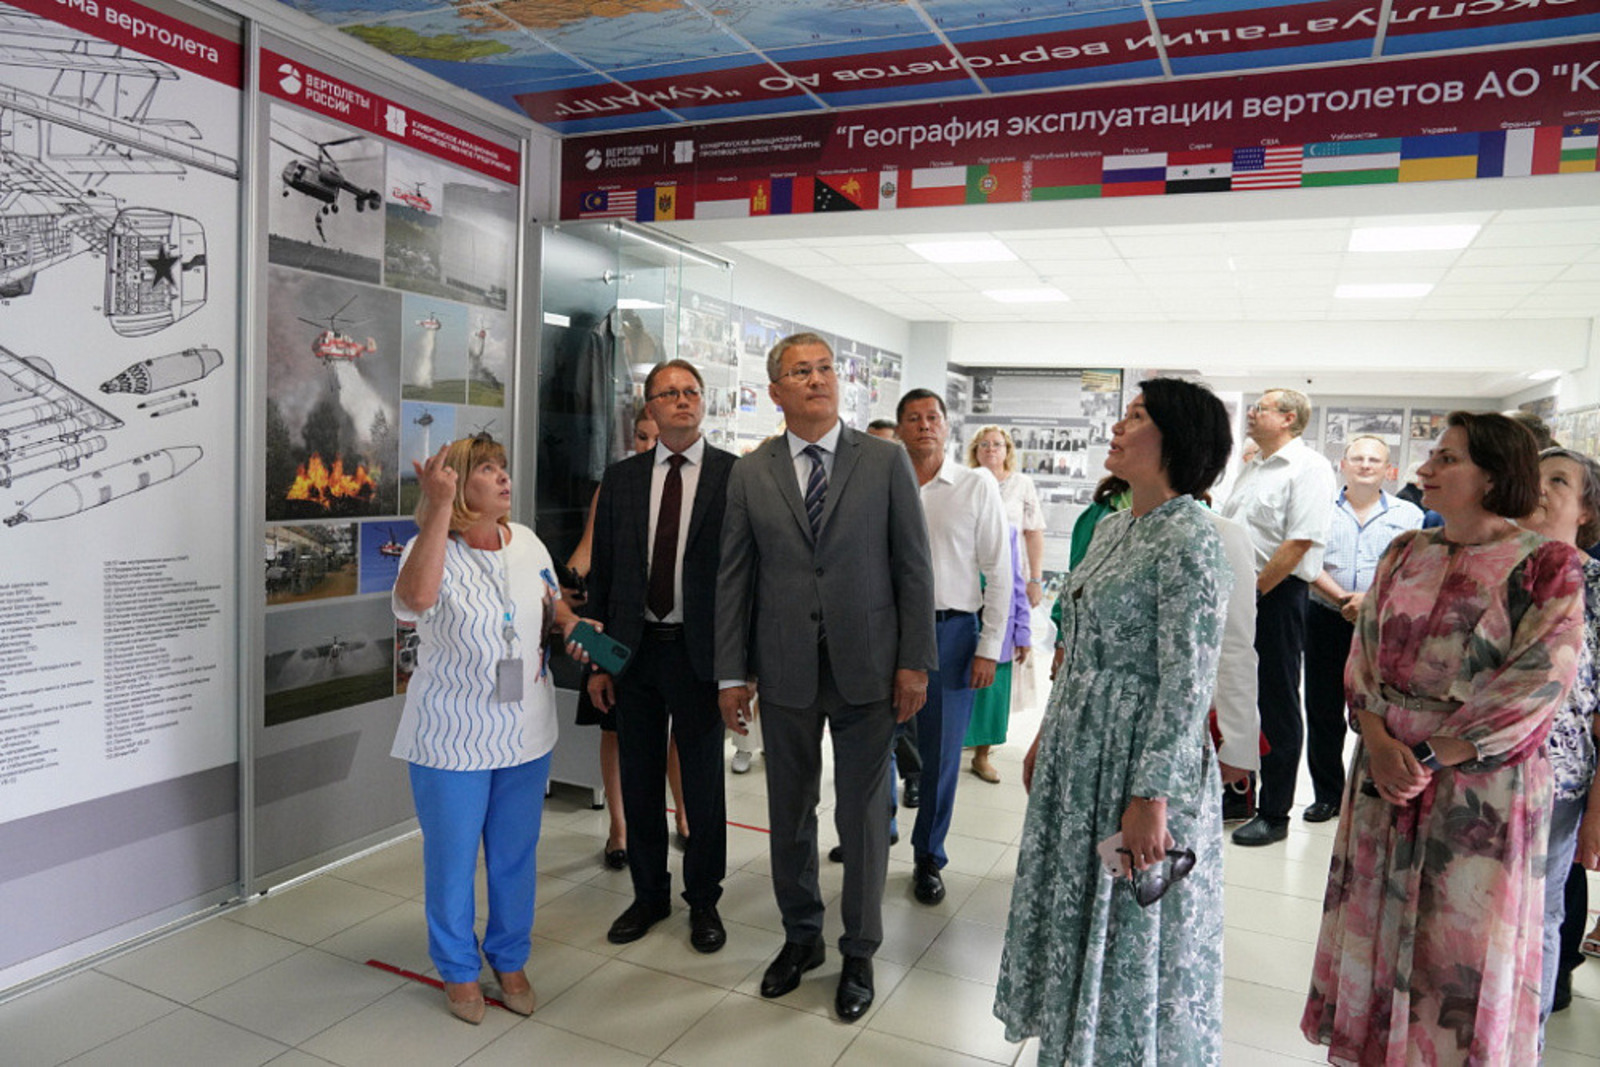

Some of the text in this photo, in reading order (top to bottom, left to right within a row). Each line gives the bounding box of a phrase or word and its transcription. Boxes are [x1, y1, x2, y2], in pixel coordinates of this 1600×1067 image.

[105, 7, 219, 63] вертолета
[832, 42, 1110, 82] вертолетов
[305, 73, 371, 109] ВЕРТОЛЕТЫ
[759, 73, 819, 91] АО
[305, 87, 350, 115] РОССИИ
[1006, 99, 1233, 137] эксплуатации
[1242, 80, 1465, 122] вертолетов
[1474, 67, 1541, 100] АО
[605, 144, 659, 158] ВЕРТОЛЕТЫ
[1260, 138, 1280, 146] США
[605, 156, 641, 169] РОССИИ
